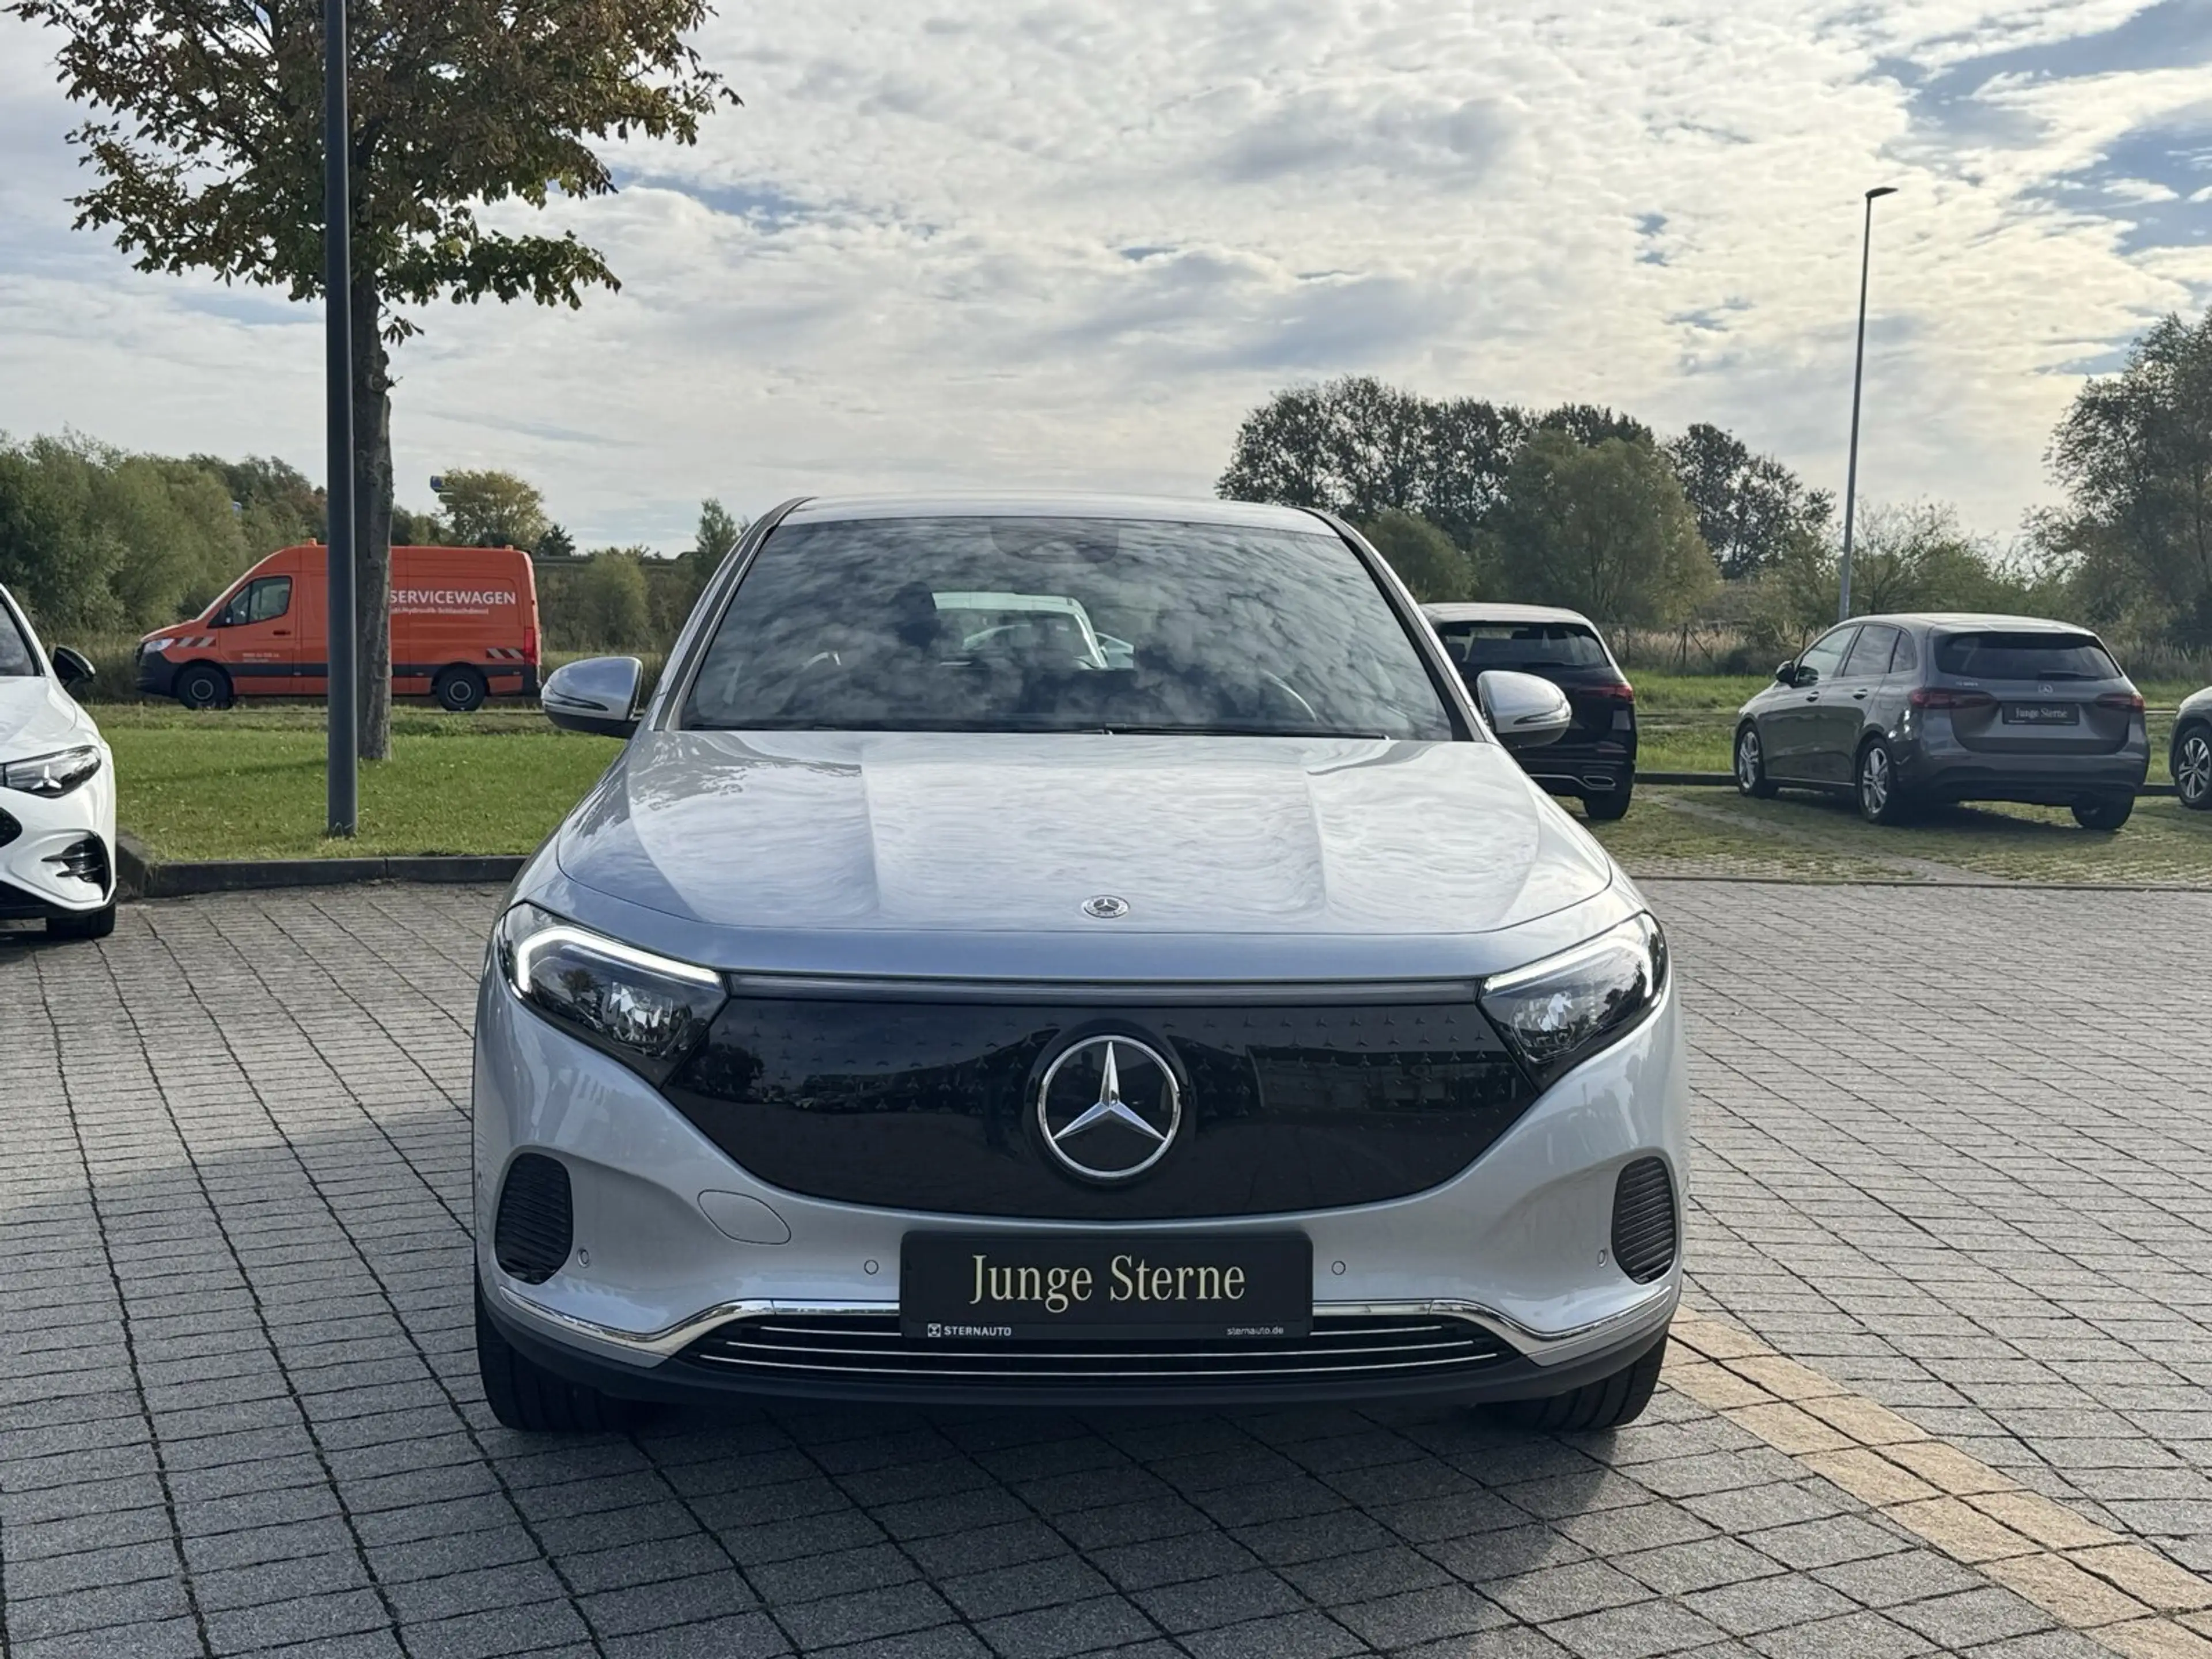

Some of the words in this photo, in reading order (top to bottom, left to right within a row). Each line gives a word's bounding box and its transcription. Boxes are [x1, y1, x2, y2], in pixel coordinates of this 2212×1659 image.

[389, 590, 516, 605] SERVICEWAGEN
[969, 1255, 1092, 1313] Junge
[1109, 1254, 1245, 1301] Sterne
[944, 1326, 1012, 1336] STERNAUTO
